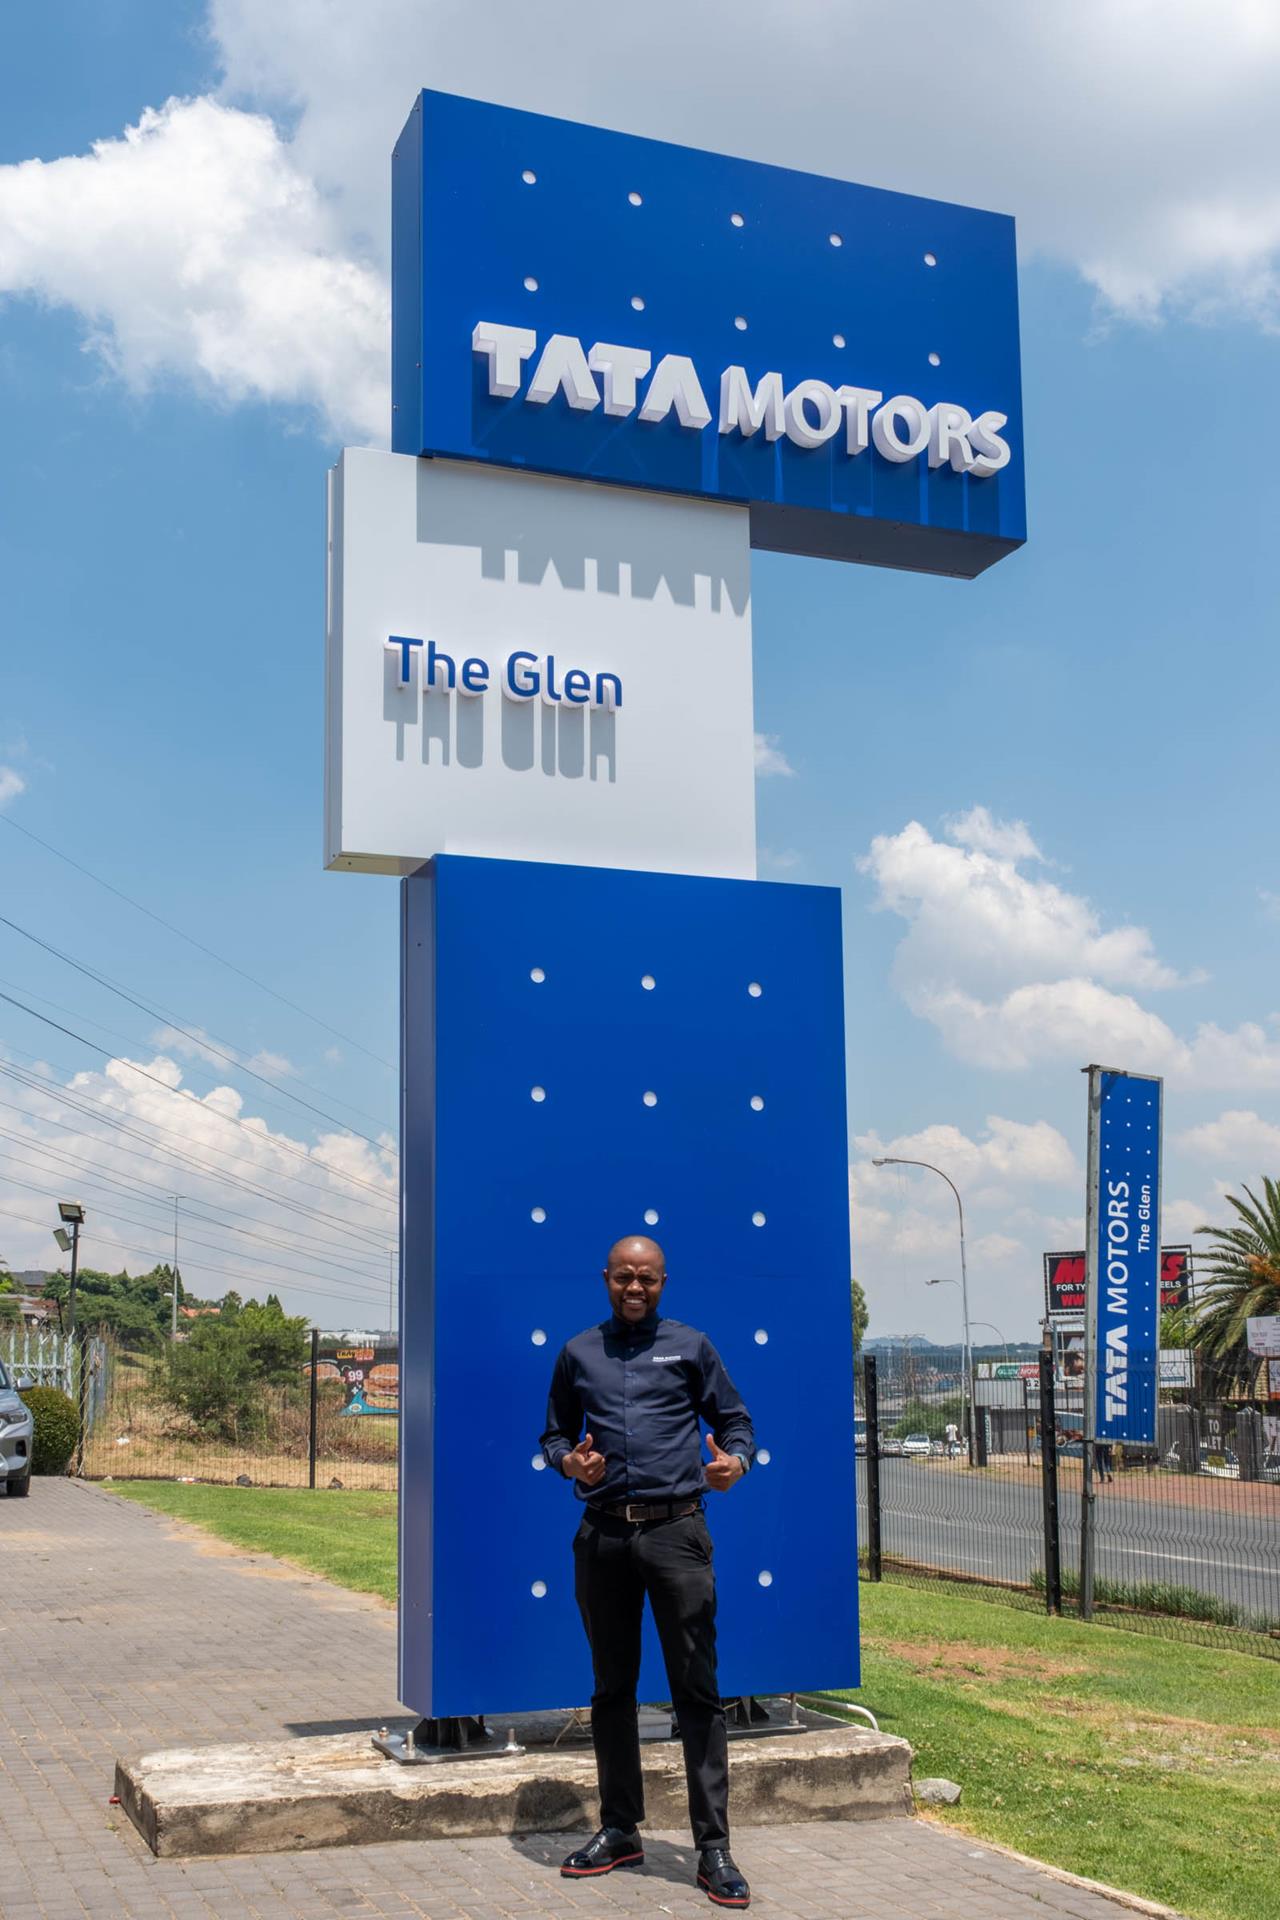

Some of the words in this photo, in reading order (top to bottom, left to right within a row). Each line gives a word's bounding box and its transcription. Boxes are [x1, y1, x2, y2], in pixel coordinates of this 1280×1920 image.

[472, 321, 712, 429] TATA
[718, 365, 1011, 478] MOTORS
[386, 635, 489, 694] The
[505, 651, 623, 709] Glen
[1138, 1184, 1151, 1220] Glen
[1107, 1181, 1130, 1315] MOTORS
[1138, 1223, 1150, 1253] The
[1056, 1283, 1074, 1292] FOR
[1160, 1280, 1182, 1289] EELS
[1105, 1324, 1128, 1422] TATA
[1207, 1436, 1222, 1451] LET
[1208, 1419, 1220, 1434] TO
